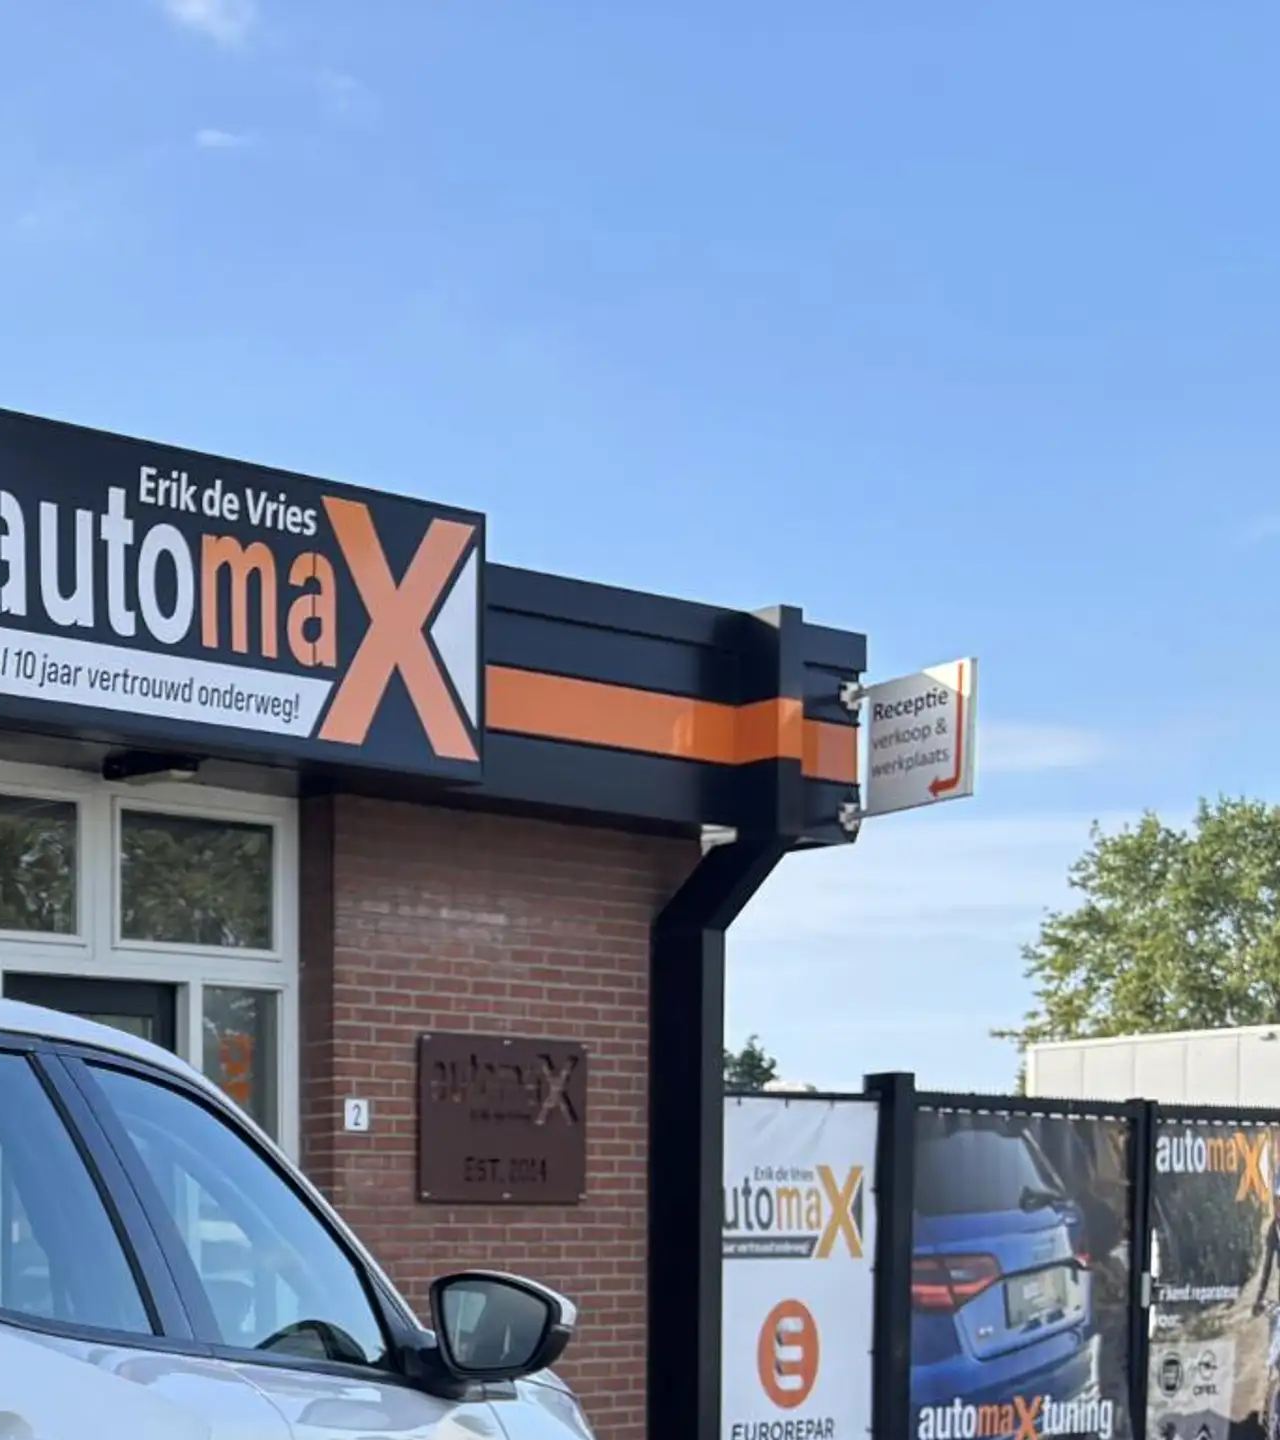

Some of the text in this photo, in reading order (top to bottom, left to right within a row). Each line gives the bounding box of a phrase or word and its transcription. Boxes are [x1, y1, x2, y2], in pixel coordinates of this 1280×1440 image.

[139, 465, 317, 536] Erik de Vries
[14, 648, 36, 680] 10
[39, 654, 83, 688] jaar
[87, 665, 194, 704] vertrouwd
[197, 682, 301, 724] onderweg!
[873, 687, 949, 721] Receptie
[872, 717, 947, 751] verkoop &
[871, 749, 950, 776] werkplaats
[352, 1103, 362, 1127] 2
[754, 1167, 773, 1181] Erik
[1155, 1127, 1269, 1202] automaX
[722, 1165, 863, 1259] utomaX
